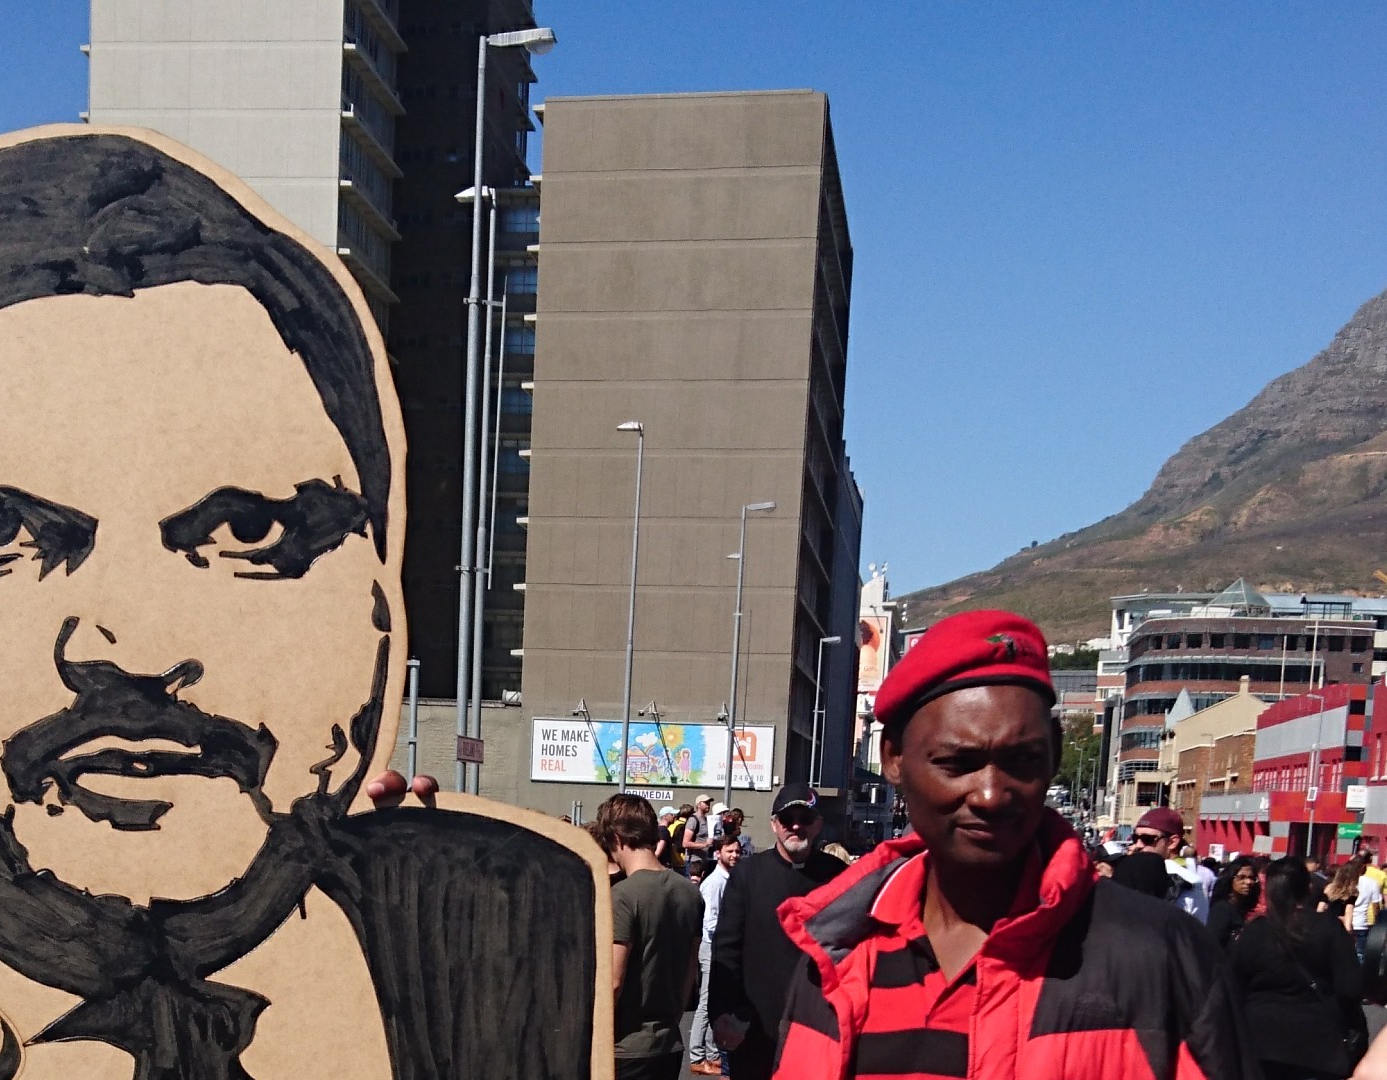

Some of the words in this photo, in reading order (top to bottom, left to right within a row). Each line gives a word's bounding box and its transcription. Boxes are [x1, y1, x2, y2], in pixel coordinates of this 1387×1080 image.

[541, 728, 558, 741] WE
[561, 729, 590, 743] MAKE
[541, 743, 578, 757] HOMES
[540, 758, 566, 772] REAL
